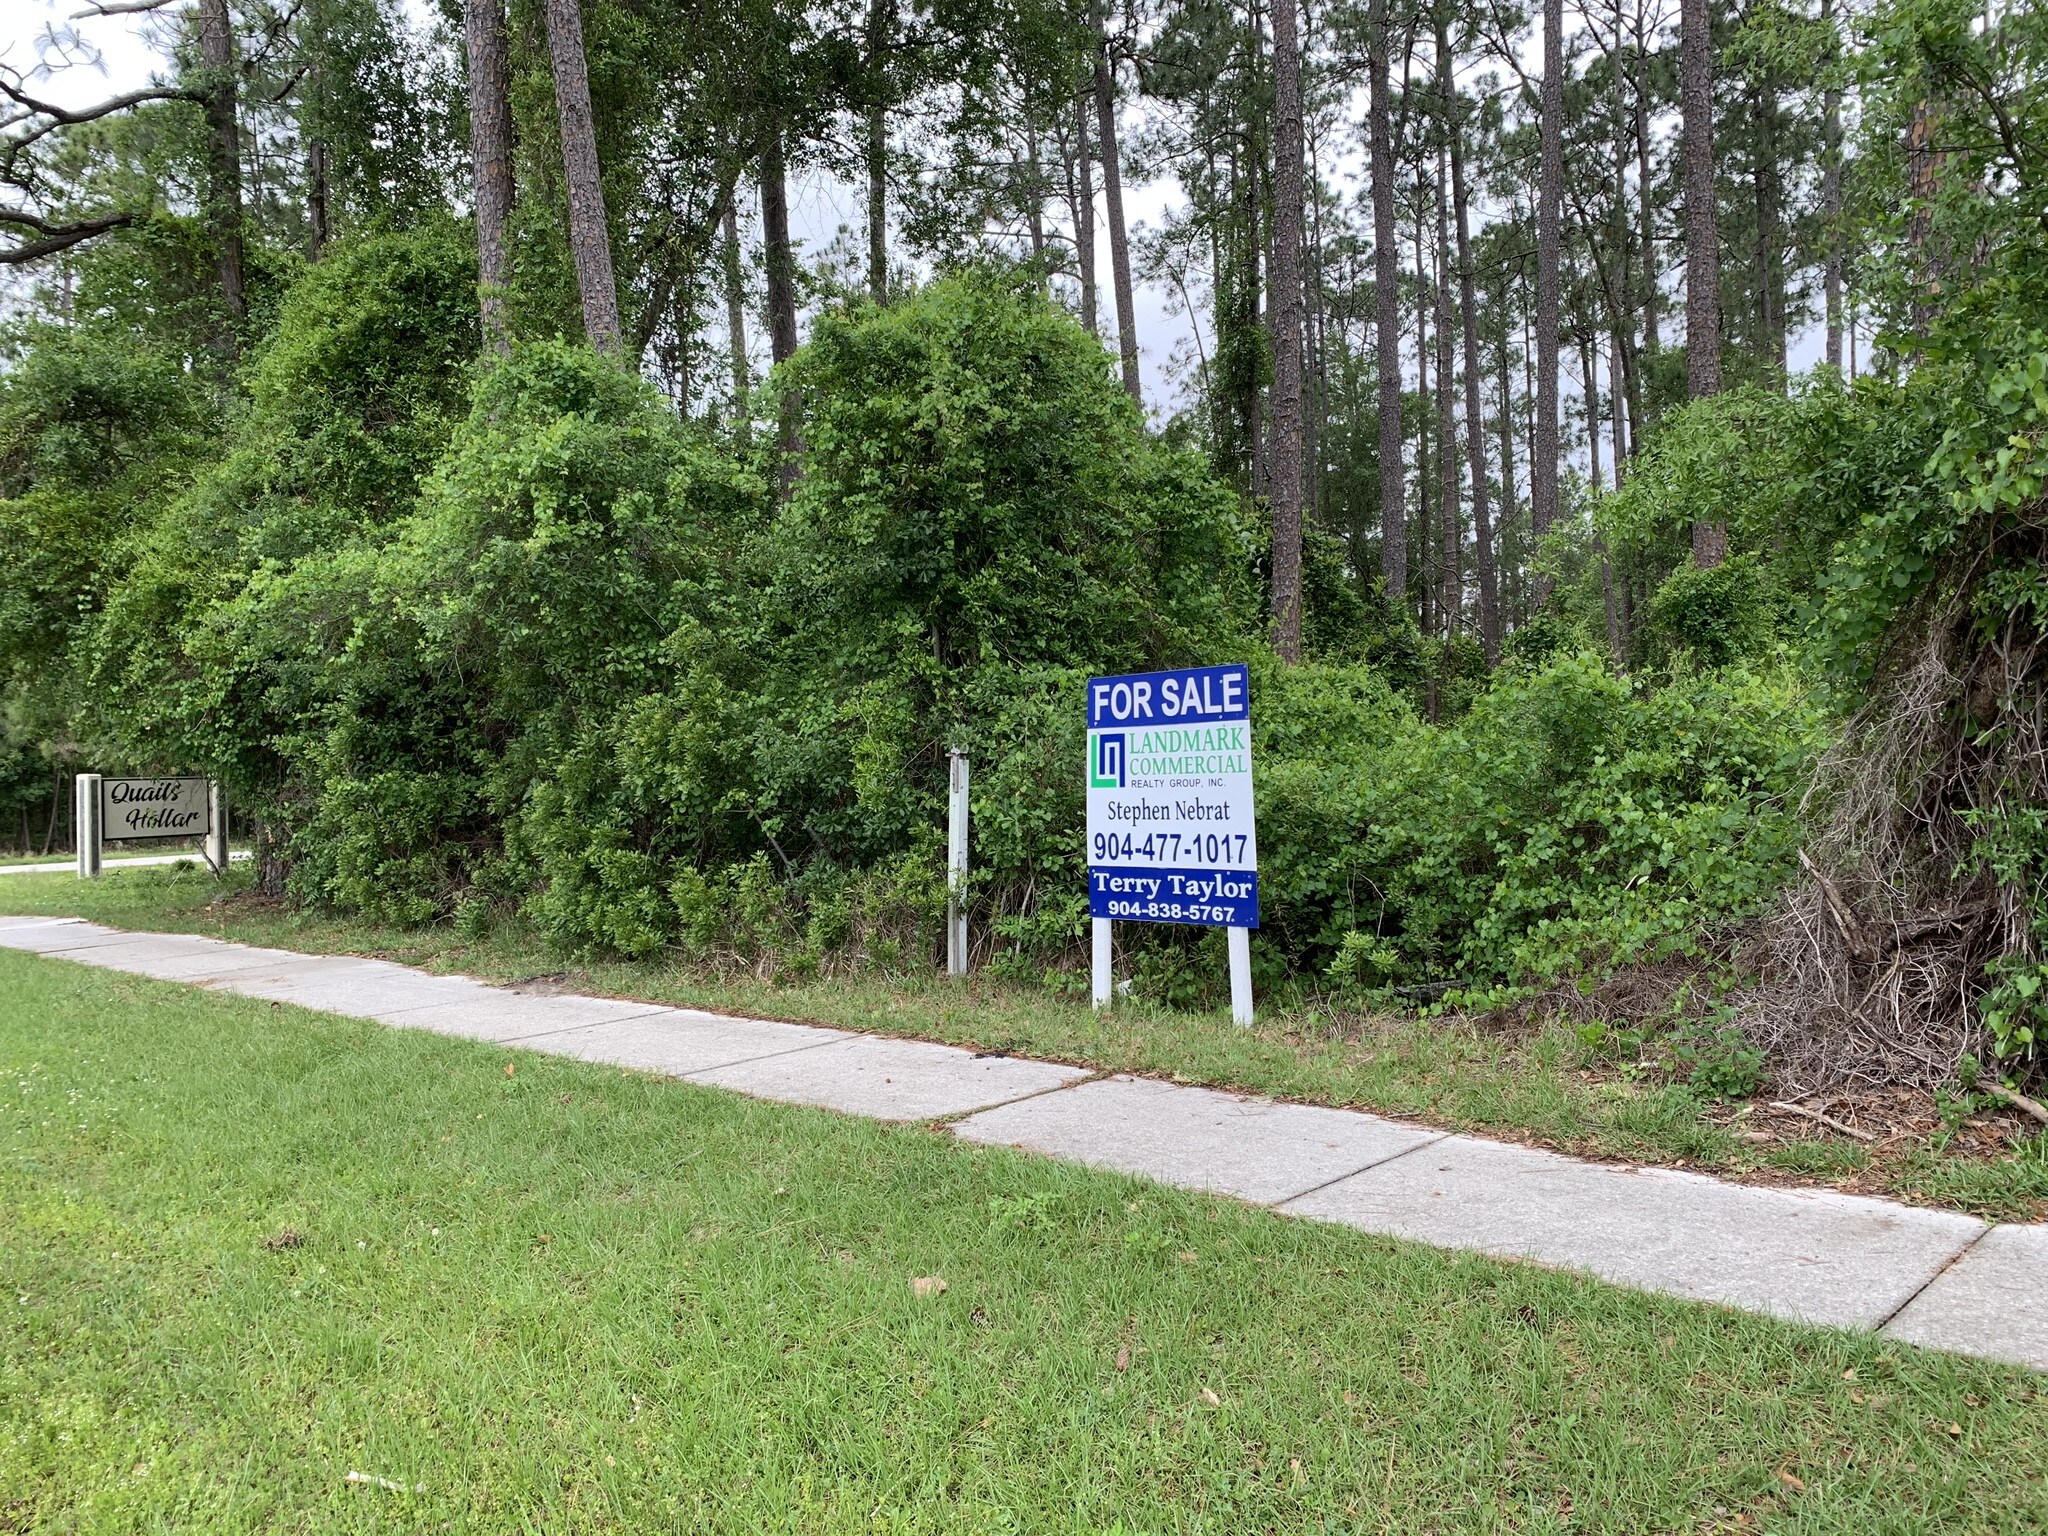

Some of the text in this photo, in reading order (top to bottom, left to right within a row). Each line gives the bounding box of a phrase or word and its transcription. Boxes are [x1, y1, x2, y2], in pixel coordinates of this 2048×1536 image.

[1094, 673, 1243, 721] FOR SALE
[1129, 727, 1245, 754] LANDMARK
[1130, 755, 1247, 776] COMMERCIAL
[1131, 779, 1164, 788] REALTY
[1208, 778, 1226, 787] INC.
[125, 808, 200, 831] Hollar
[1108, 797, 1230, 826] Stephen Nebrat
[1094, 832, 1248, 864] 904-477-1017
[1093, 873, 1252, 902] Terry Taylor
[1108, 901, 1235, 922] 904-838-5767
